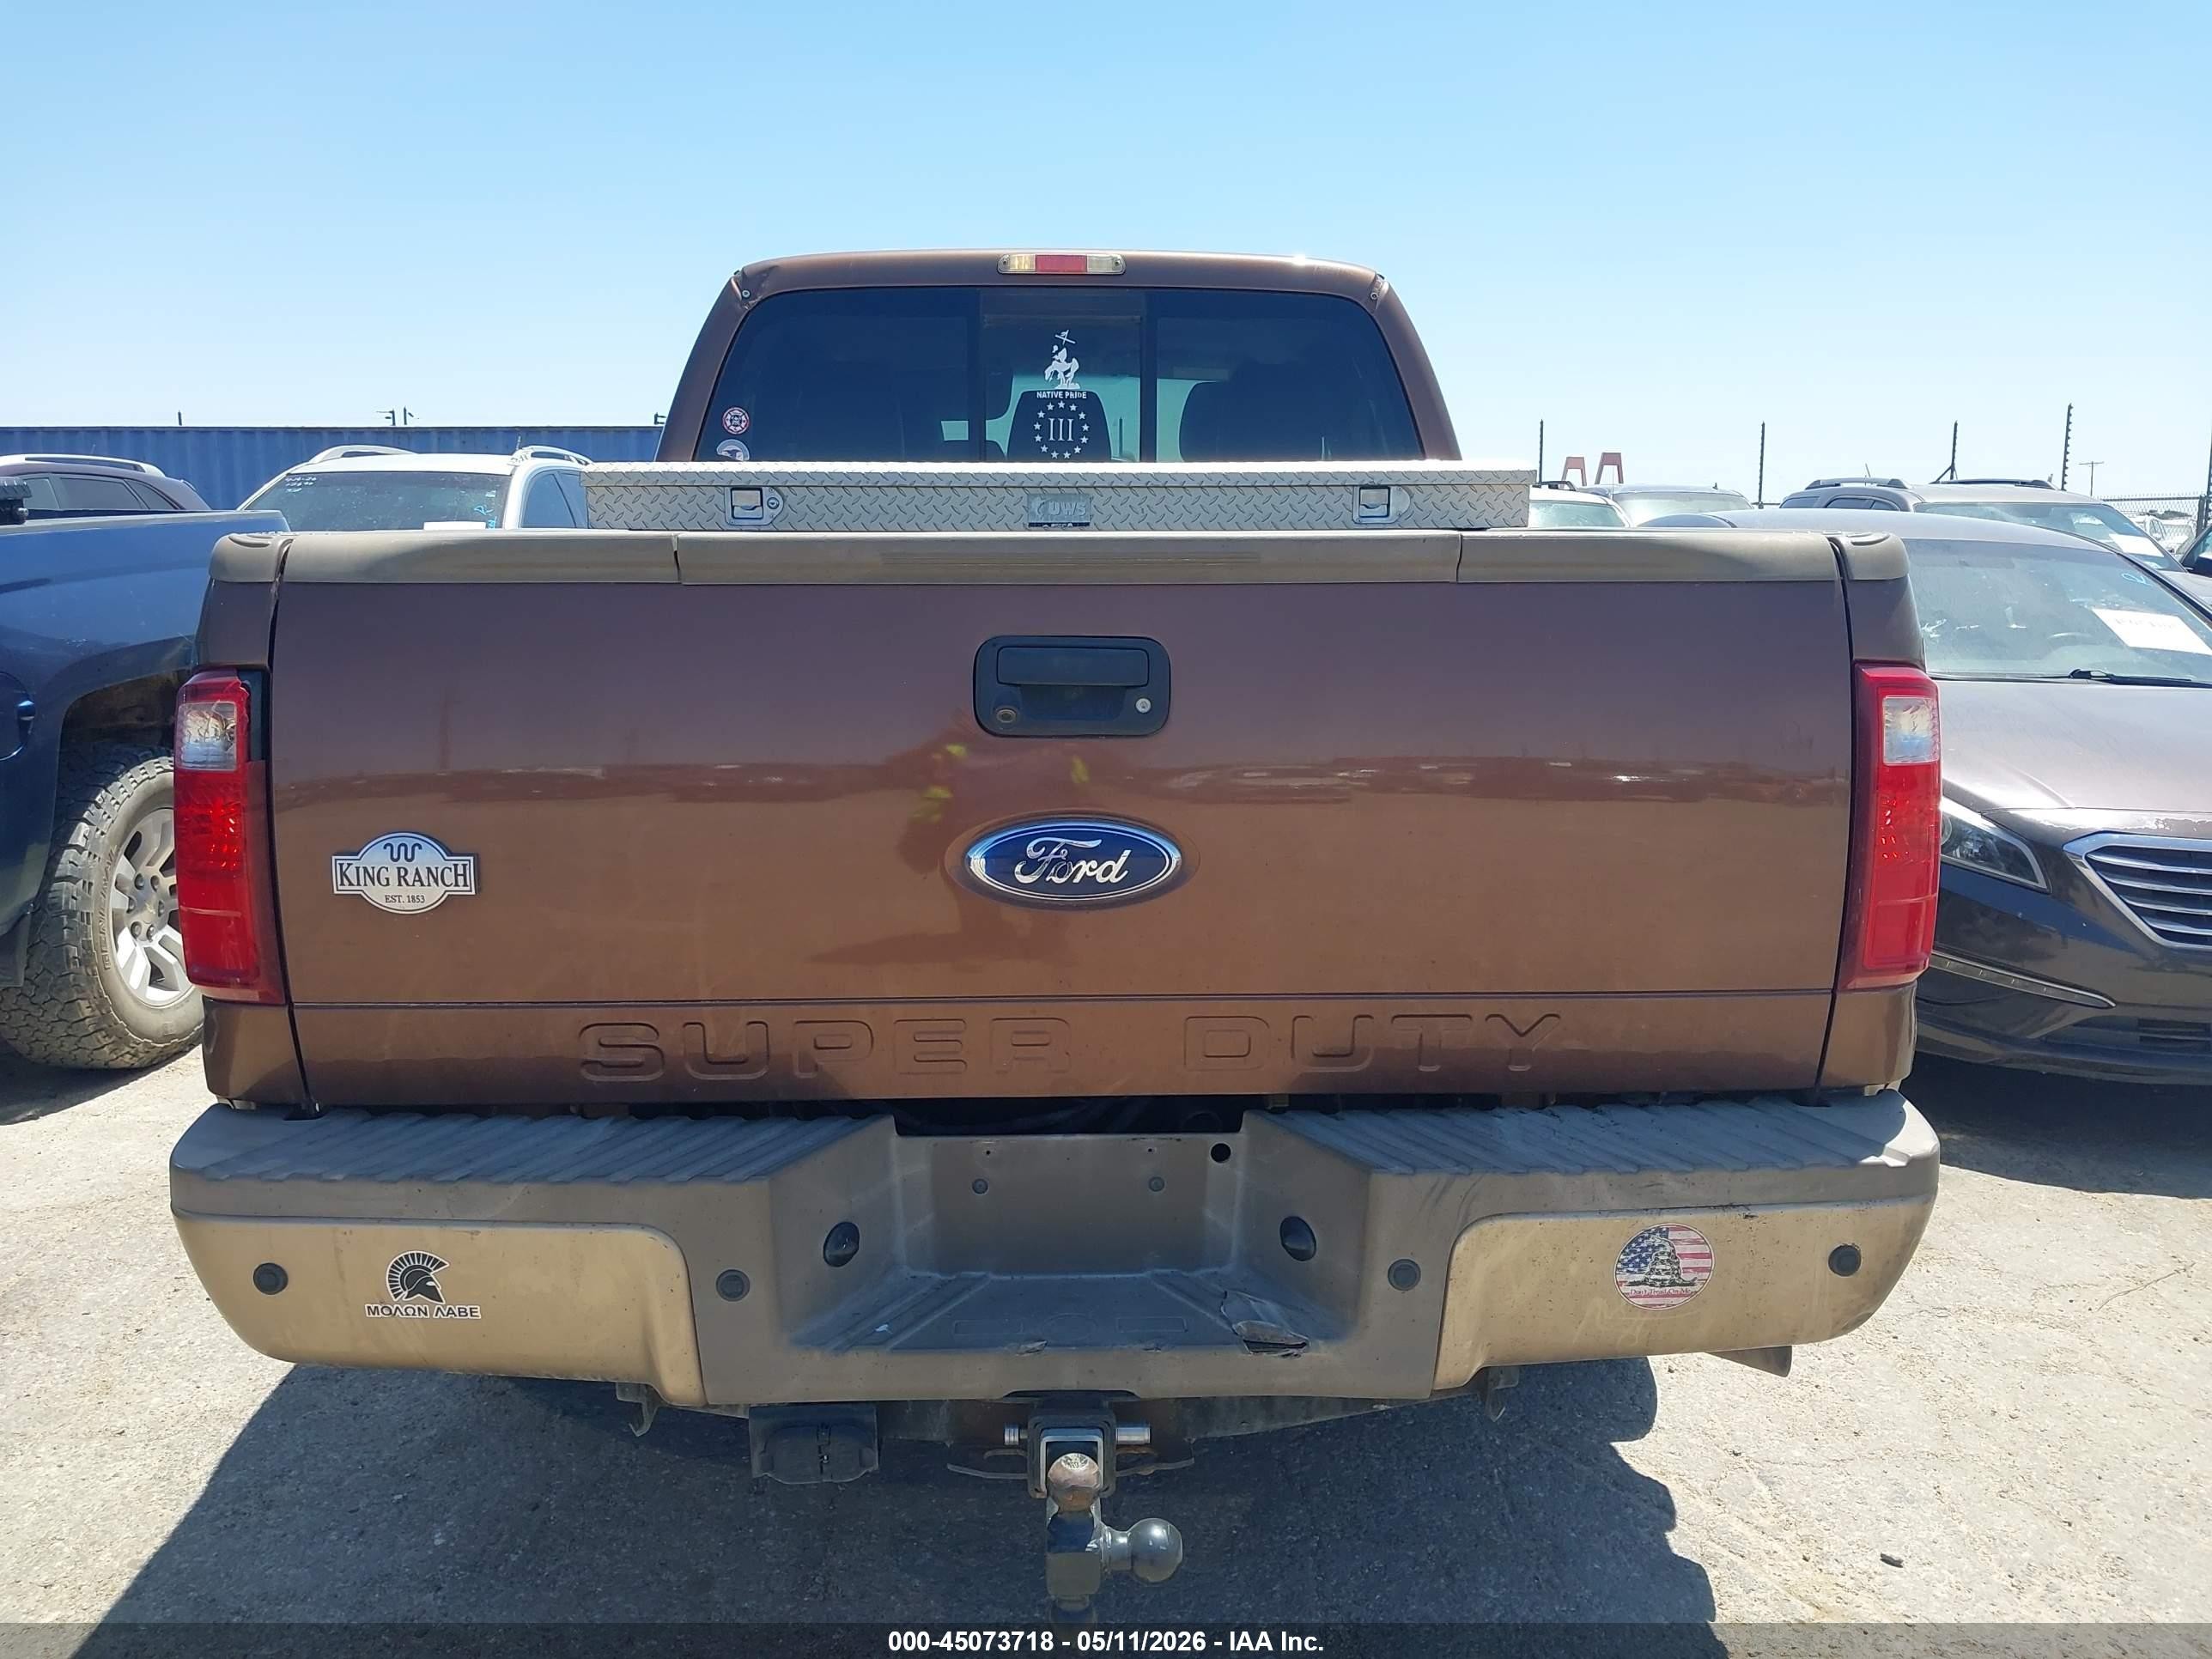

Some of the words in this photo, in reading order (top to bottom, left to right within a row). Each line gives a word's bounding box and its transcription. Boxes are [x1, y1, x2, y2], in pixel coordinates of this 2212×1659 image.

[1036, 391, 1064, 399] NATIVE
[1065, 391, 1087, 399] PRIDE
[1048, 417, 1074, 442] III
[1013, 836, 1133, 884] Ford
[337, 862, 391, 888] KING
[396, 863, 470, 888] RANCH
[384, 894, 405, 904] EST.
[406, 894, 426, 903] 1853
[574, 1016, 1074, 1084] SUPER
[1183, 1012, 1563, 1076] DUTY
